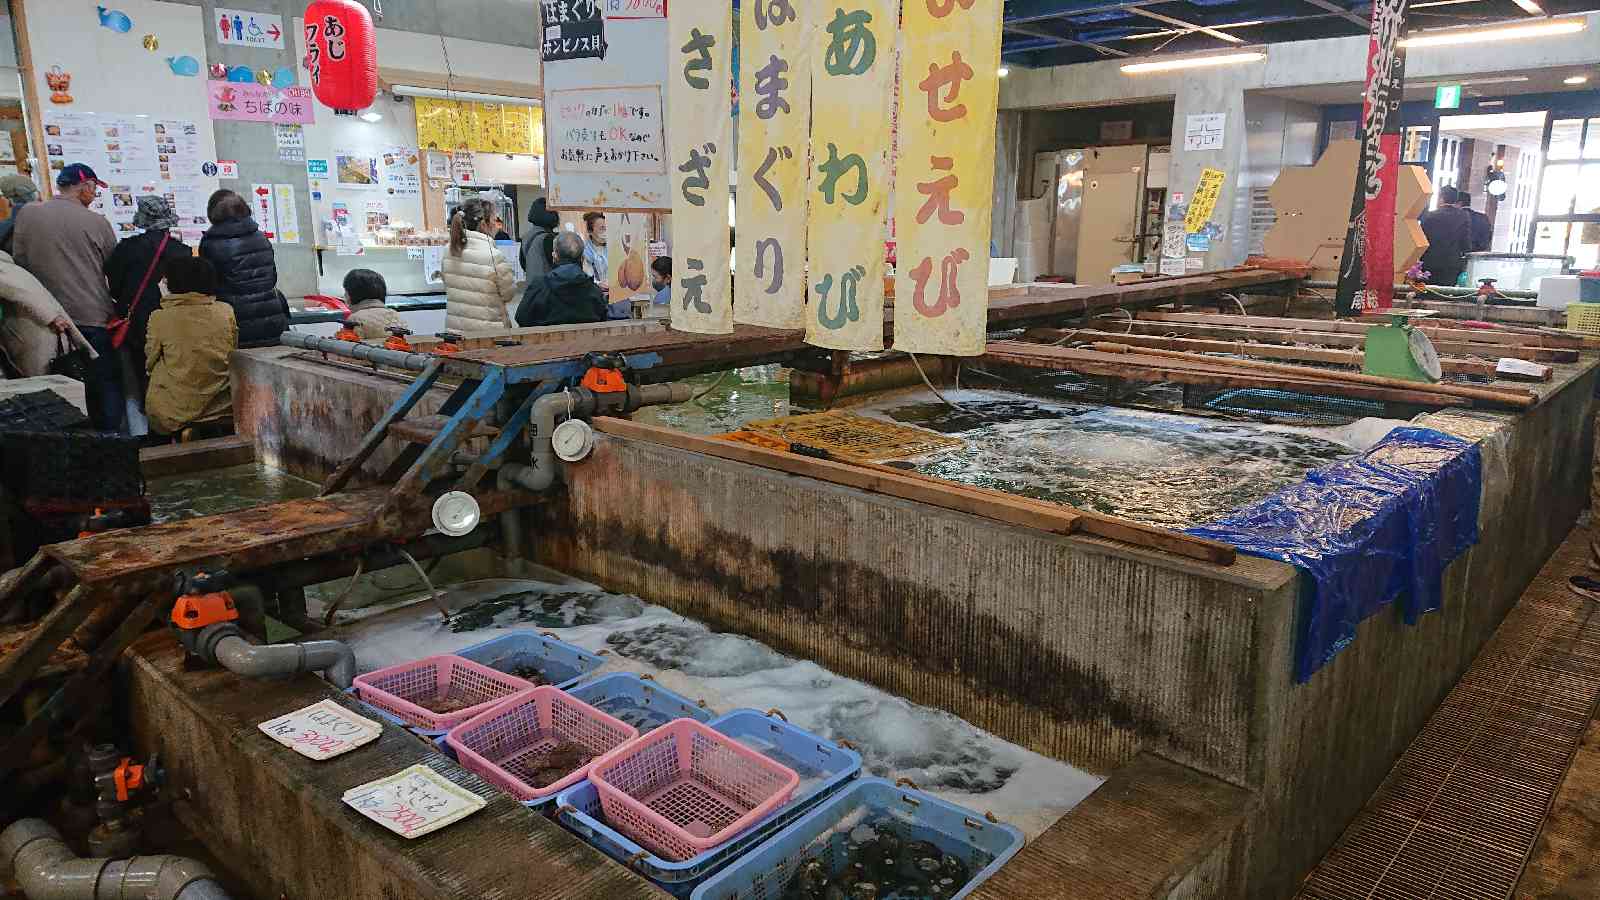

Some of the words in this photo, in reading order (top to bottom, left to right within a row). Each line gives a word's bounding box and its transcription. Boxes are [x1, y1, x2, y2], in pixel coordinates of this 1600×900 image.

[243, 99, 304, 116] ちばの味
[306, 24, 320, 84] フライ
[323, 14, 345, 60] あじ
[678, 27, 717, 314] さざえ
[815, 7, 877, 330] あわび
[908, 0, 974, 318] せえび
